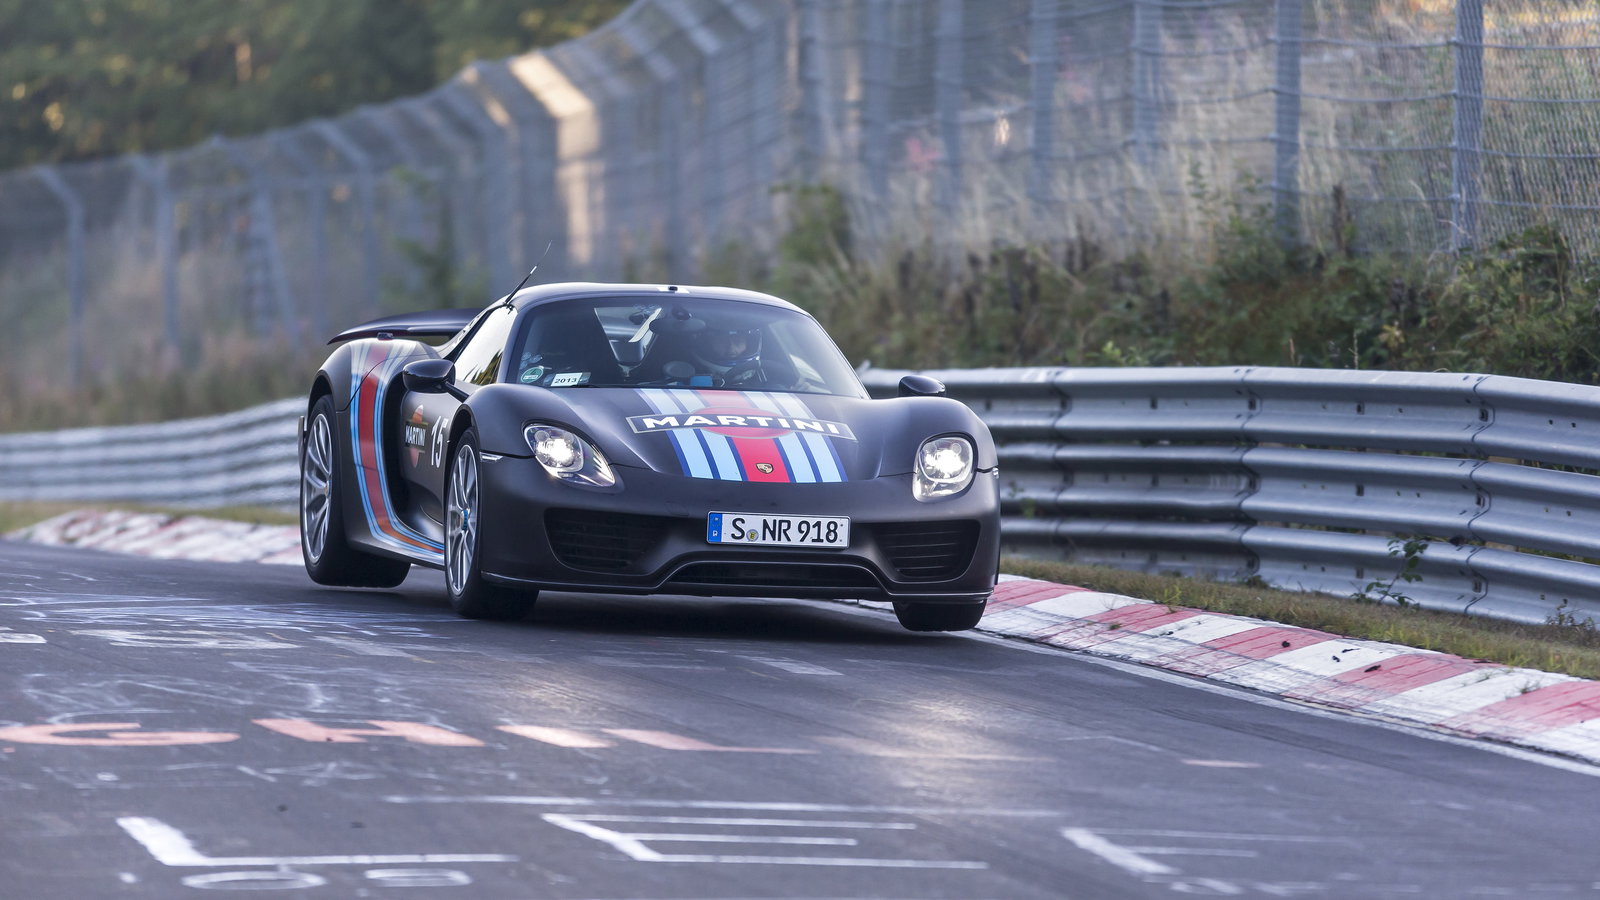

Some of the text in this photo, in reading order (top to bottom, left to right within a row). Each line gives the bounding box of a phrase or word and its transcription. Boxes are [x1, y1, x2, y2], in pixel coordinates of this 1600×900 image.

[405, 425, 427, 447] MARTINI
[642, 415, 840, 434] MARTINI
[431, 416, 449, 468] 15
[731, 518, 839, 543] S NR 918
